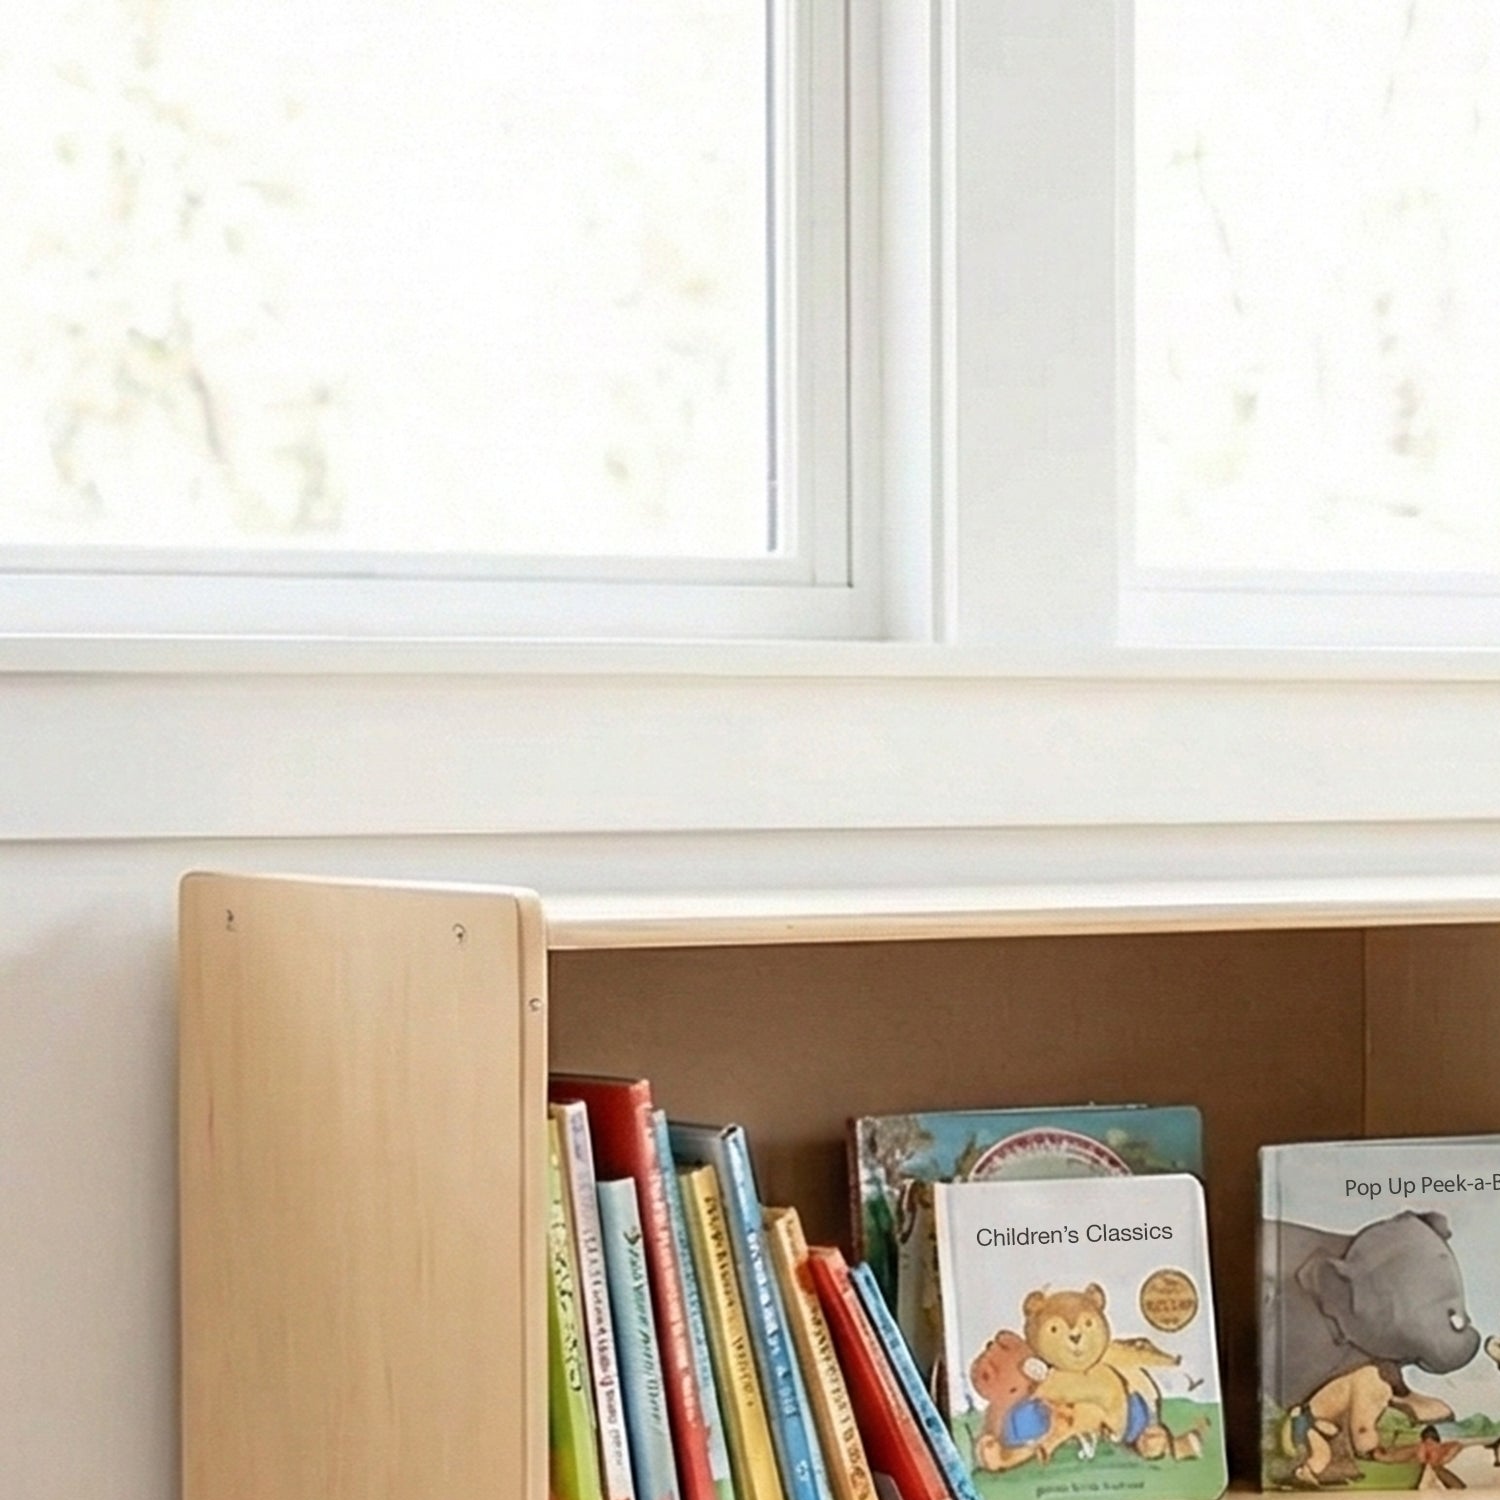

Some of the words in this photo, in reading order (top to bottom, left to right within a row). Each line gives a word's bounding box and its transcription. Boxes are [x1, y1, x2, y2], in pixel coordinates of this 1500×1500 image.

[1345, 1179, 1382, 1201] Pop
[1388, 1176, 1416, 1199] Up
[976, 1225, 1080, 1247] Children’s
[1086, 1222, 1173, 1243] Classics
